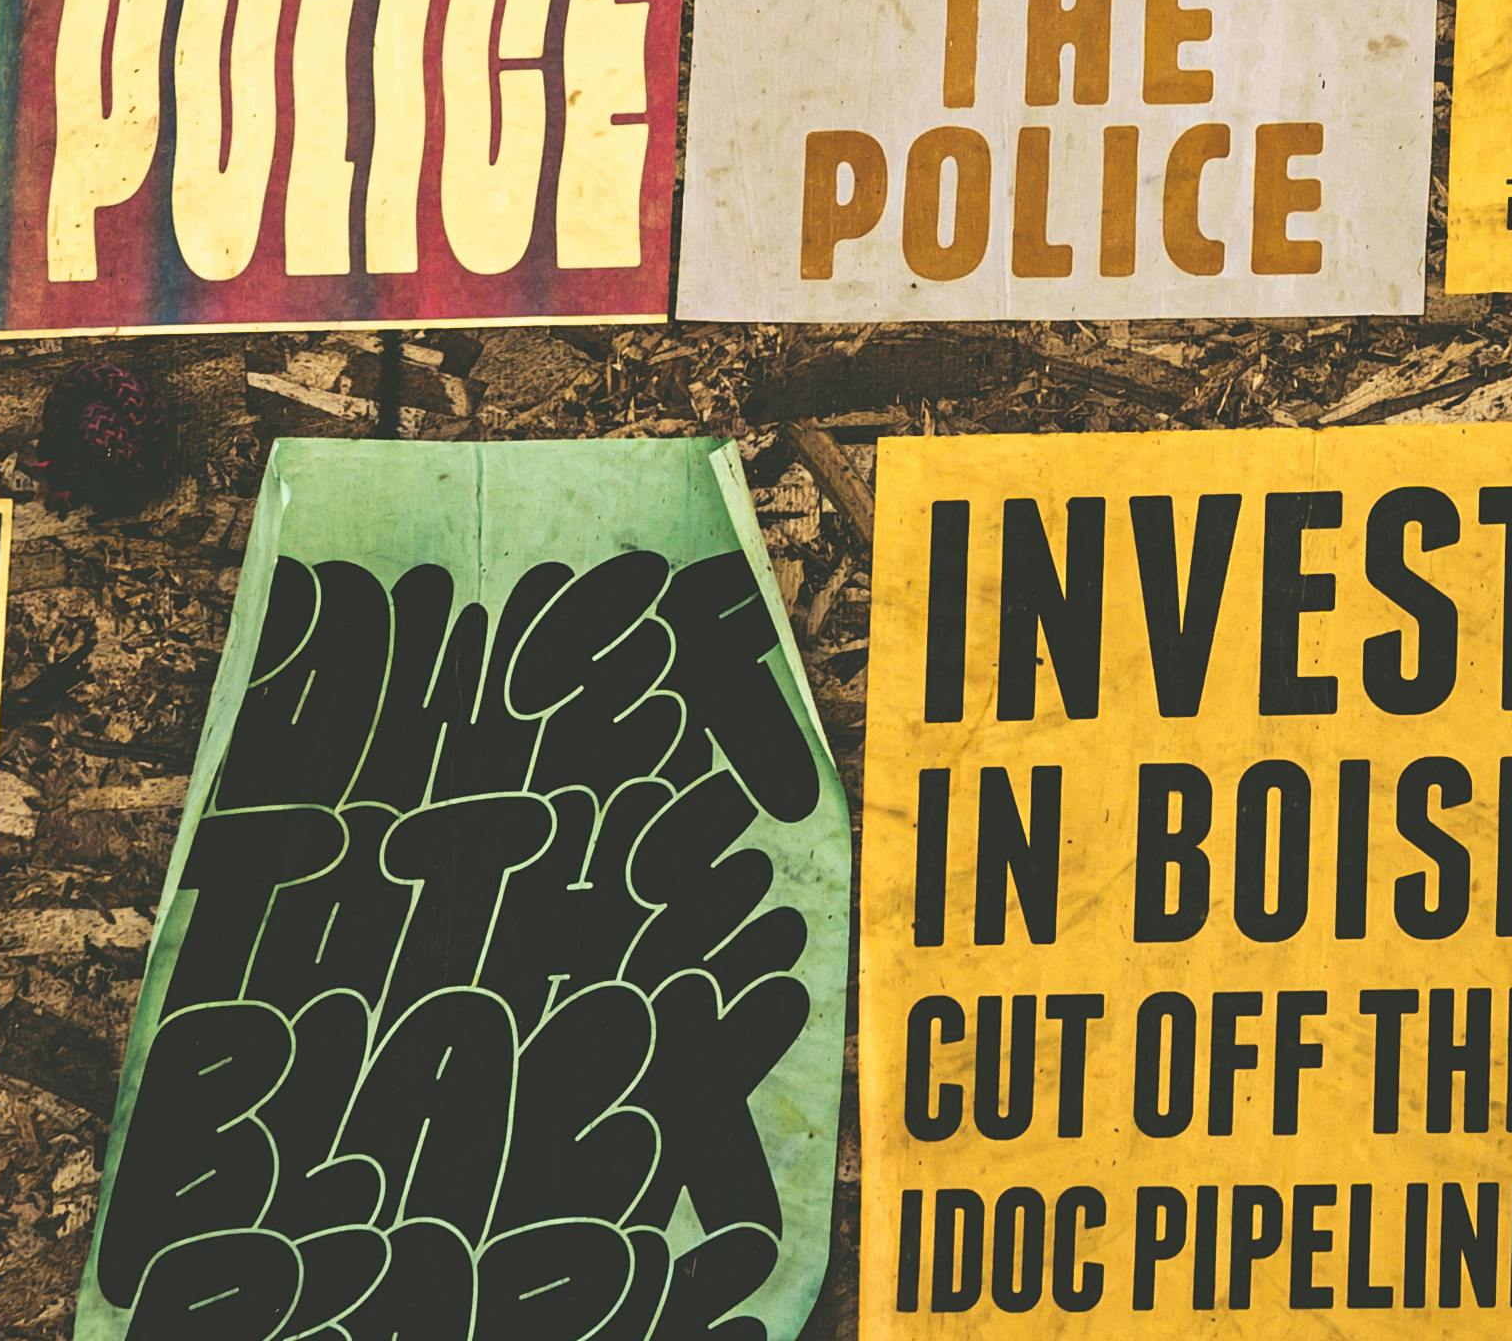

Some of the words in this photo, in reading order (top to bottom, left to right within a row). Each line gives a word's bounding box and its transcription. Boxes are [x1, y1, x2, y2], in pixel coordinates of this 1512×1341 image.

[799, 121, 1324, 283] POLICE
[912, 766, 1062, 947] IN
[97, 967, 810, 1310] BLACK
[905, 994, 1104, 1141] CUT
[1134, 991, 1327, 1138] OFF
[897, 1186, 1106, 1312] IDOC
